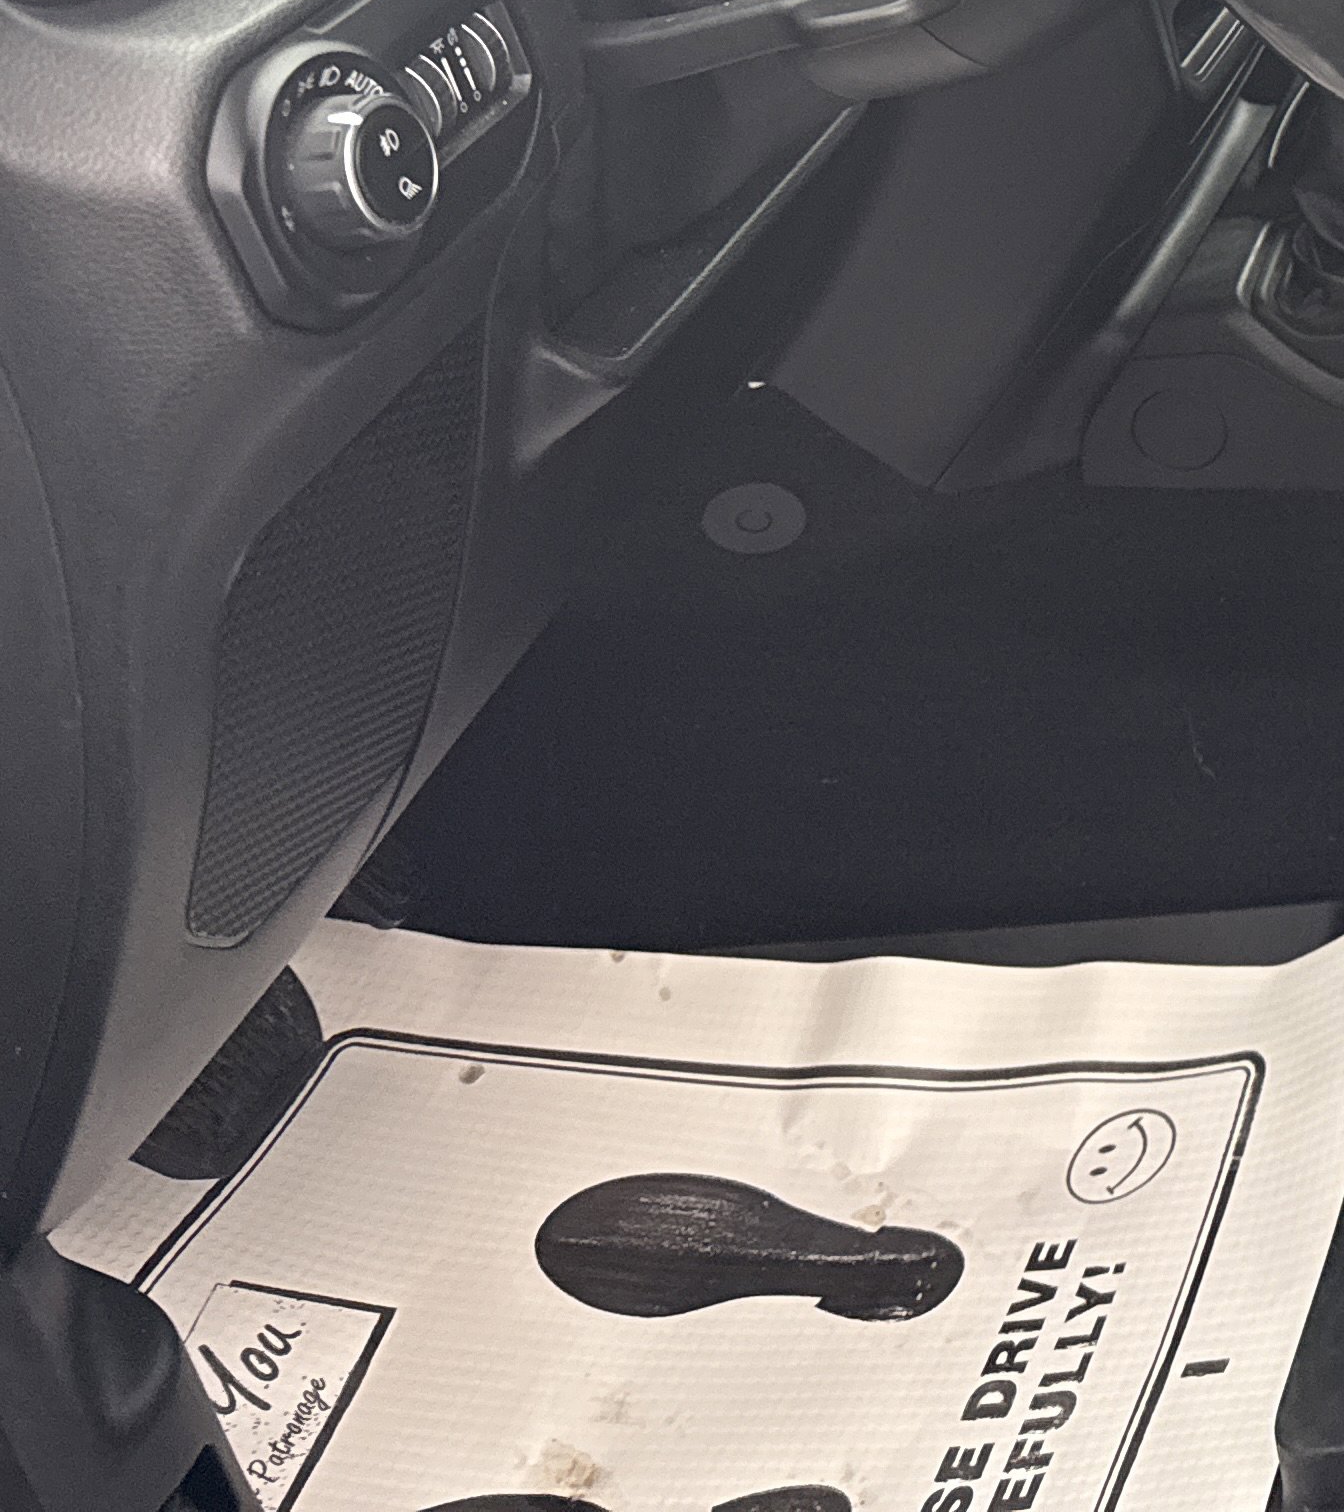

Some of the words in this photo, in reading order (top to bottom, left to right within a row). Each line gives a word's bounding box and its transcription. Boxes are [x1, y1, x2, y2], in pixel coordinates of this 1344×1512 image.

[344, 69, 385, 97] AUTO
[198, 1323, 302, 1415] You
[960, 1239, 1078, 1421] DRIVE
[246, 1377, 332, 1484] Patronage
[986, 1262, 1127, 1512] EFULLY!
